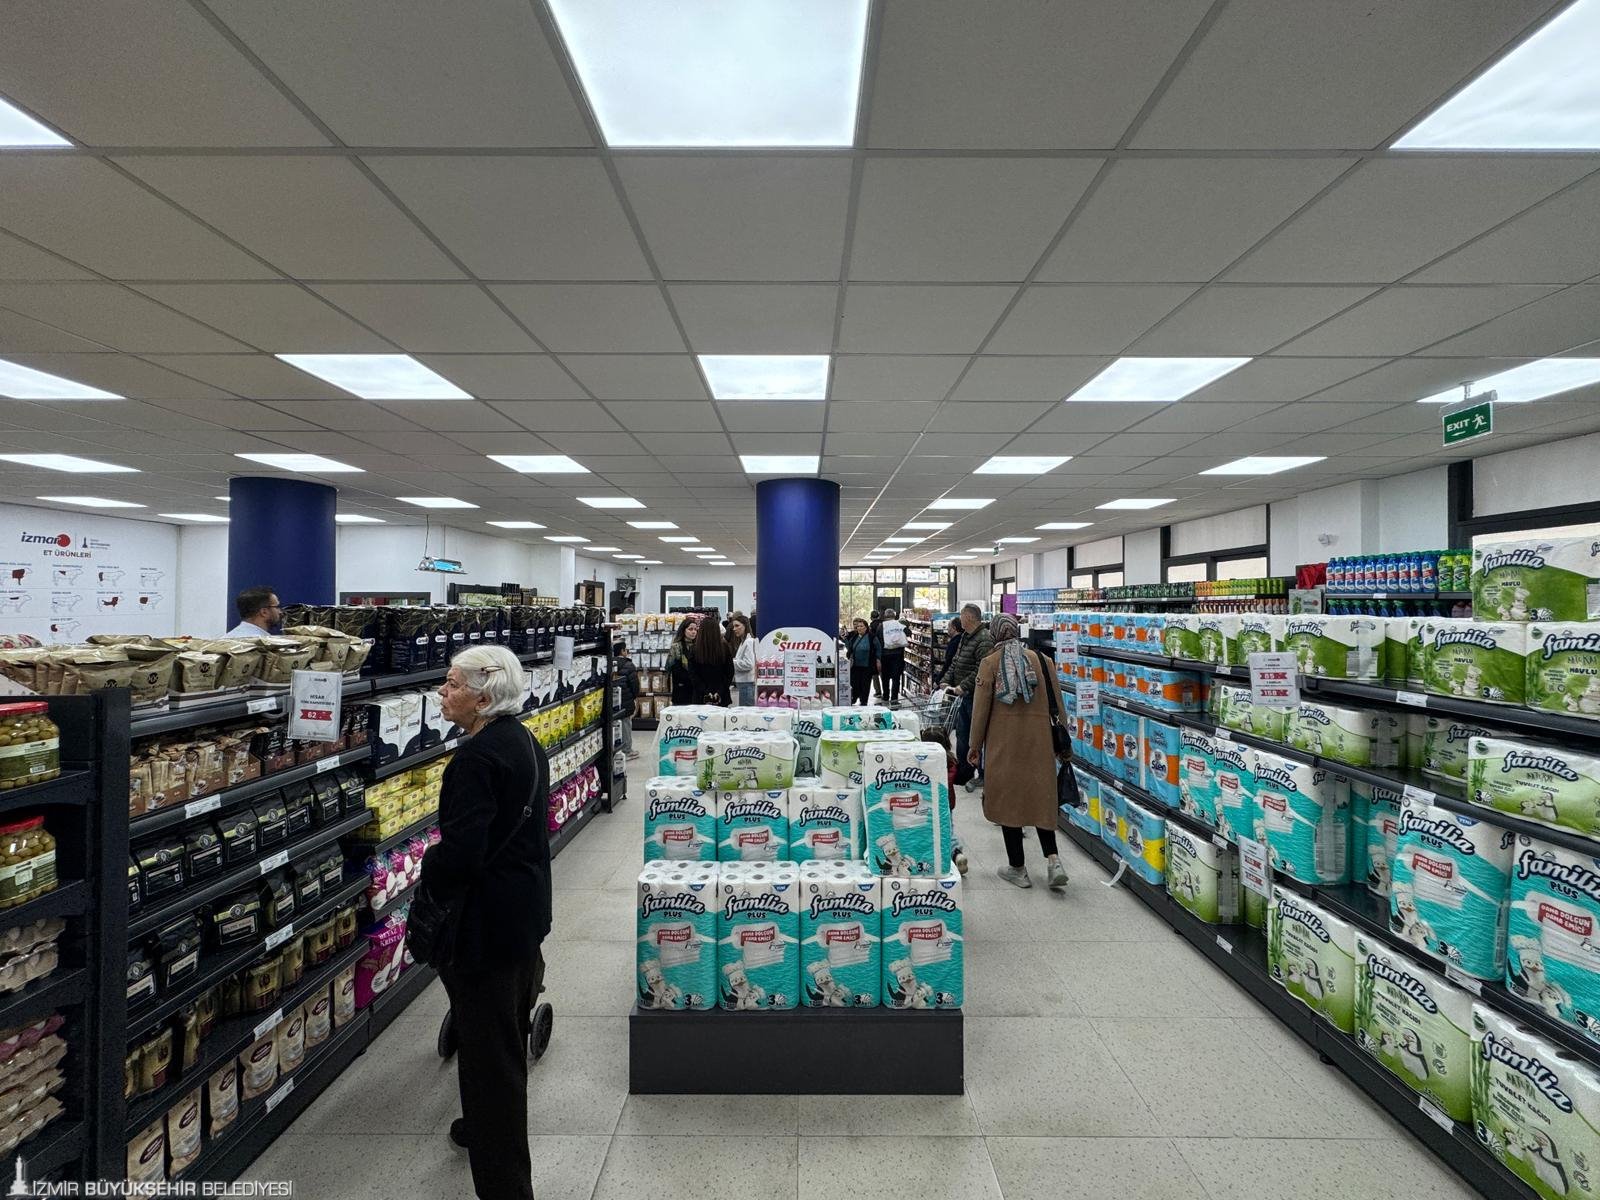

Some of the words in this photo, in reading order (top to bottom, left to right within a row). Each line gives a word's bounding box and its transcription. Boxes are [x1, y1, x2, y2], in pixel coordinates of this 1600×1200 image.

[1446, 418, 1470, 432] EXIT
[54, 549, 92, 558] ÜRÜNLERİ
[1483, 549, 1545, 578] familia
[1531, 609, 1538, 620] 3
[1288, 621, 1323, 640] familia
[1435, 628, 1497, 652] familia
[1542, 633, 1600, 660] fami
[1569, 667, 1598, 675] HAVLU
[1482, 687, 1491, 698] 3
[664, 726, 703, 744] famili
[724, 746, 766, 764] familia
[1213, 747, 1247, 771] familia
[1501, 750, 1579, 782] familia
[875, 766, 931, 790] familia
[1254, 762, 1298, 792] familia
[1475, 789, 1483, 801] 3
[649, 797, 706, 821] familia
[724, 799, 782, 825] familia
[799, 806, 850, 827] familia
[1400, 810, 1475, 855] familia
[1420, 834, 1443, 849] PLUS
[917, 862, 924, 872] 3
[1280, 860, 1287, 871] 3
[1518, 849, 1600, 902] famili
[1550, 881, 1579, 900] PLUS
[642, 893, 705, 918] familia
[725, 894, 789, 921] familia
[810, 893, 874, 920] familia
[892, 890, 956, 917] familia
[1278, 899, 1330, 943] familia
[1560, 911, 1590, 927] DOLGUN
[1439, 940, 1449, 956] 3
[1273, 964, 1281, 978] 3
[1366, 953, 1438, 1014] familia
[685, 994, 692, 1006] 3
[768, 995, 776, 1007] 3
[854, 995, 861, 1006] 3
[936, 992, 943, 1004] 3
[1576, 1009, 1589, 1028] 3
[1358, 1028, 1367, 1045] 3
[1482, 1031, 1573, 1114] familia
[1477, 1121, 1488, 1143] 3
